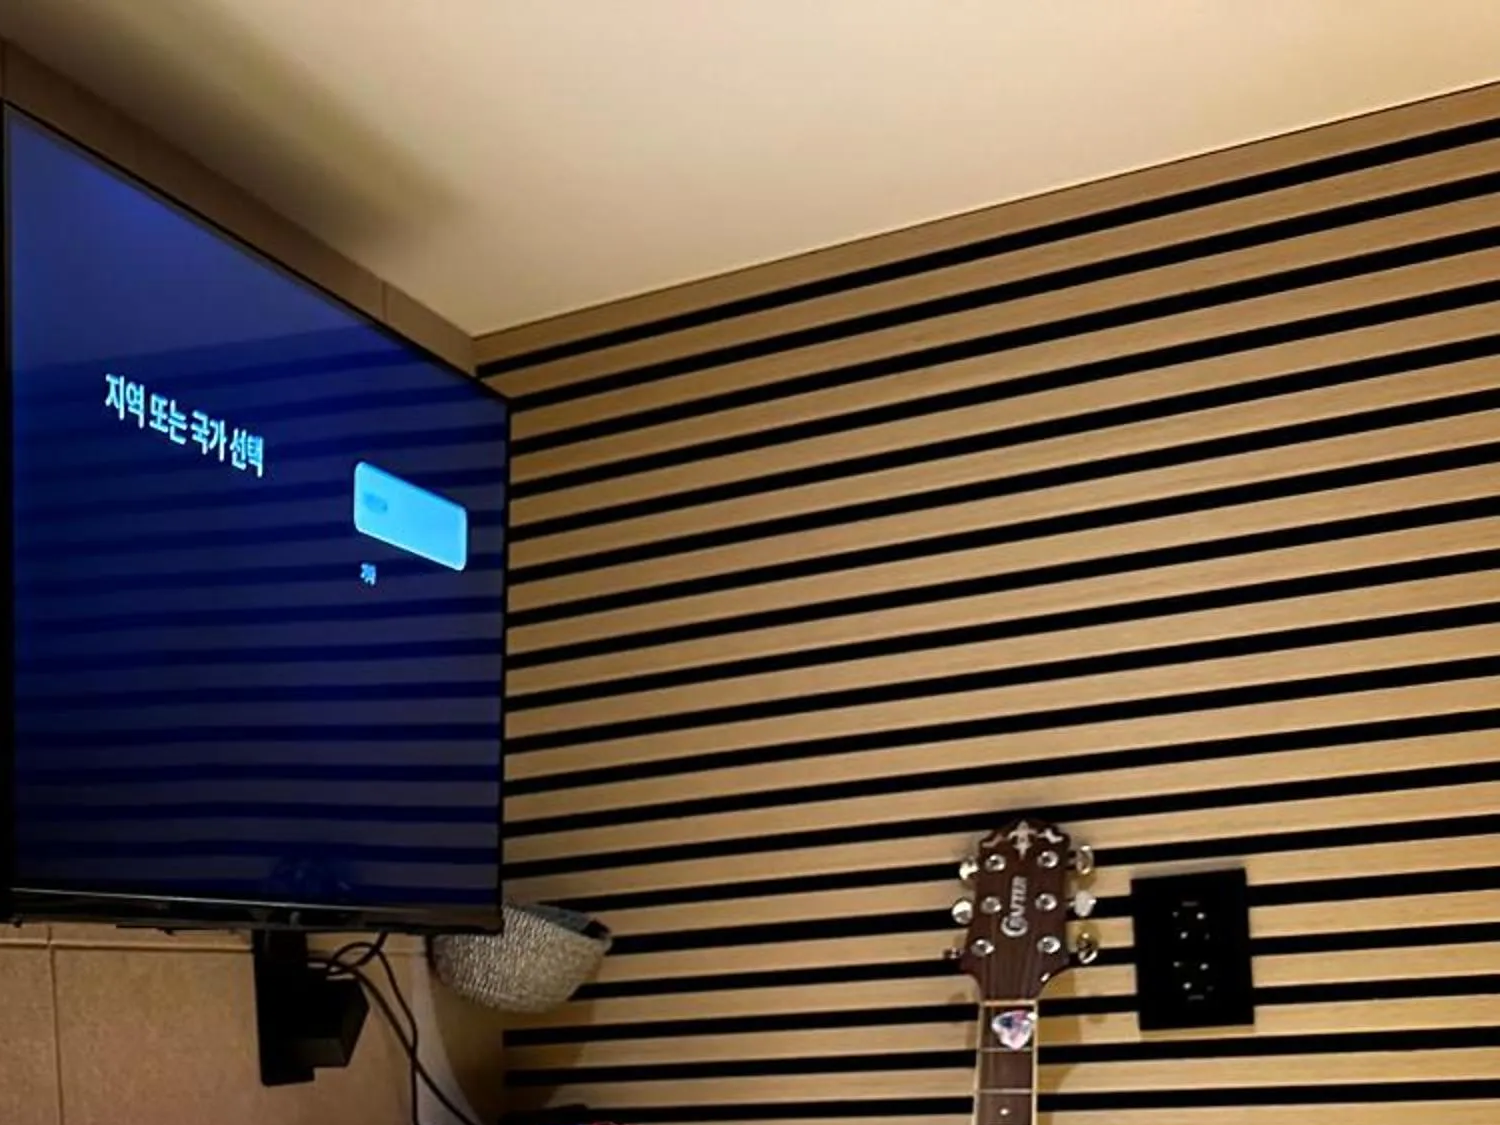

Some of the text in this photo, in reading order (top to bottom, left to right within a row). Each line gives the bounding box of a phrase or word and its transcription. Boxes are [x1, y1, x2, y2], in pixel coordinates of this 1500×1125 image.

[105, 373, 264, 479] 지역 또는 국가 선택
